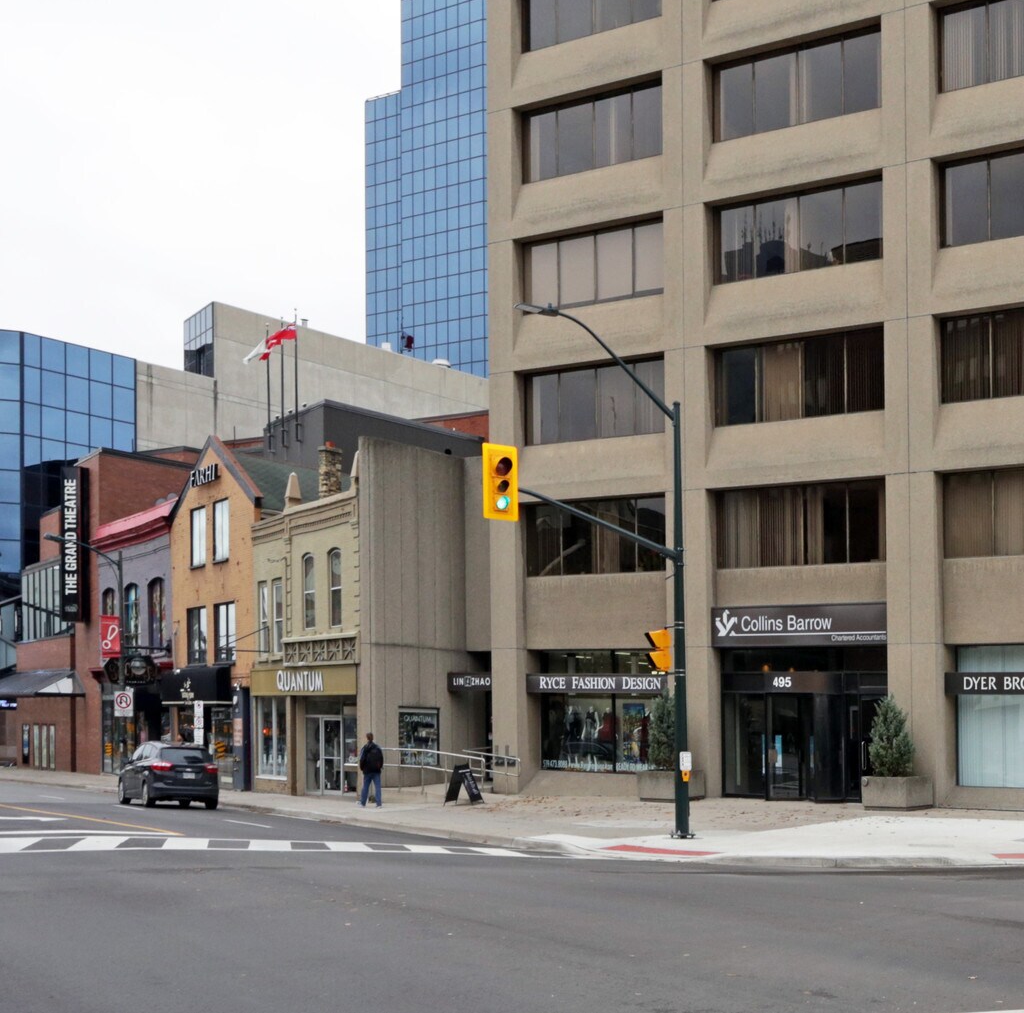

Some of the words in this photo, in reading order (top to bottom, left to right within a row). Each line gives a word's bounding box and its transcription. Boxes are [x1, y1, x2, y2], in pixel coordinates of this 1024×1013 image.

[190, 463, 216, 488] FARHI
[64, 478, 77, 530] THEATRE
[65, 531, 77, 571] GRAND
[65, 573, 77, 596] THE
[741, 616, 783, 632] Collins
[787, 615, 832, 631] Barrow
[831, 634, 855, 642] Chartered
[856, 633, 887, 641] Accountants
[276, 670, 324, 692] QUANTUM
[453, 677, 464, 686] LIN
[471, 677, 491, 686] ZHAO
[539, 676, 566, 689] RYCE
[572, 676, 616, 689] FASHION
[622, 676, 661, 689] DESIGN
[772, 676, 792, 688] 495
[963, 676, 997, 691] DYER
